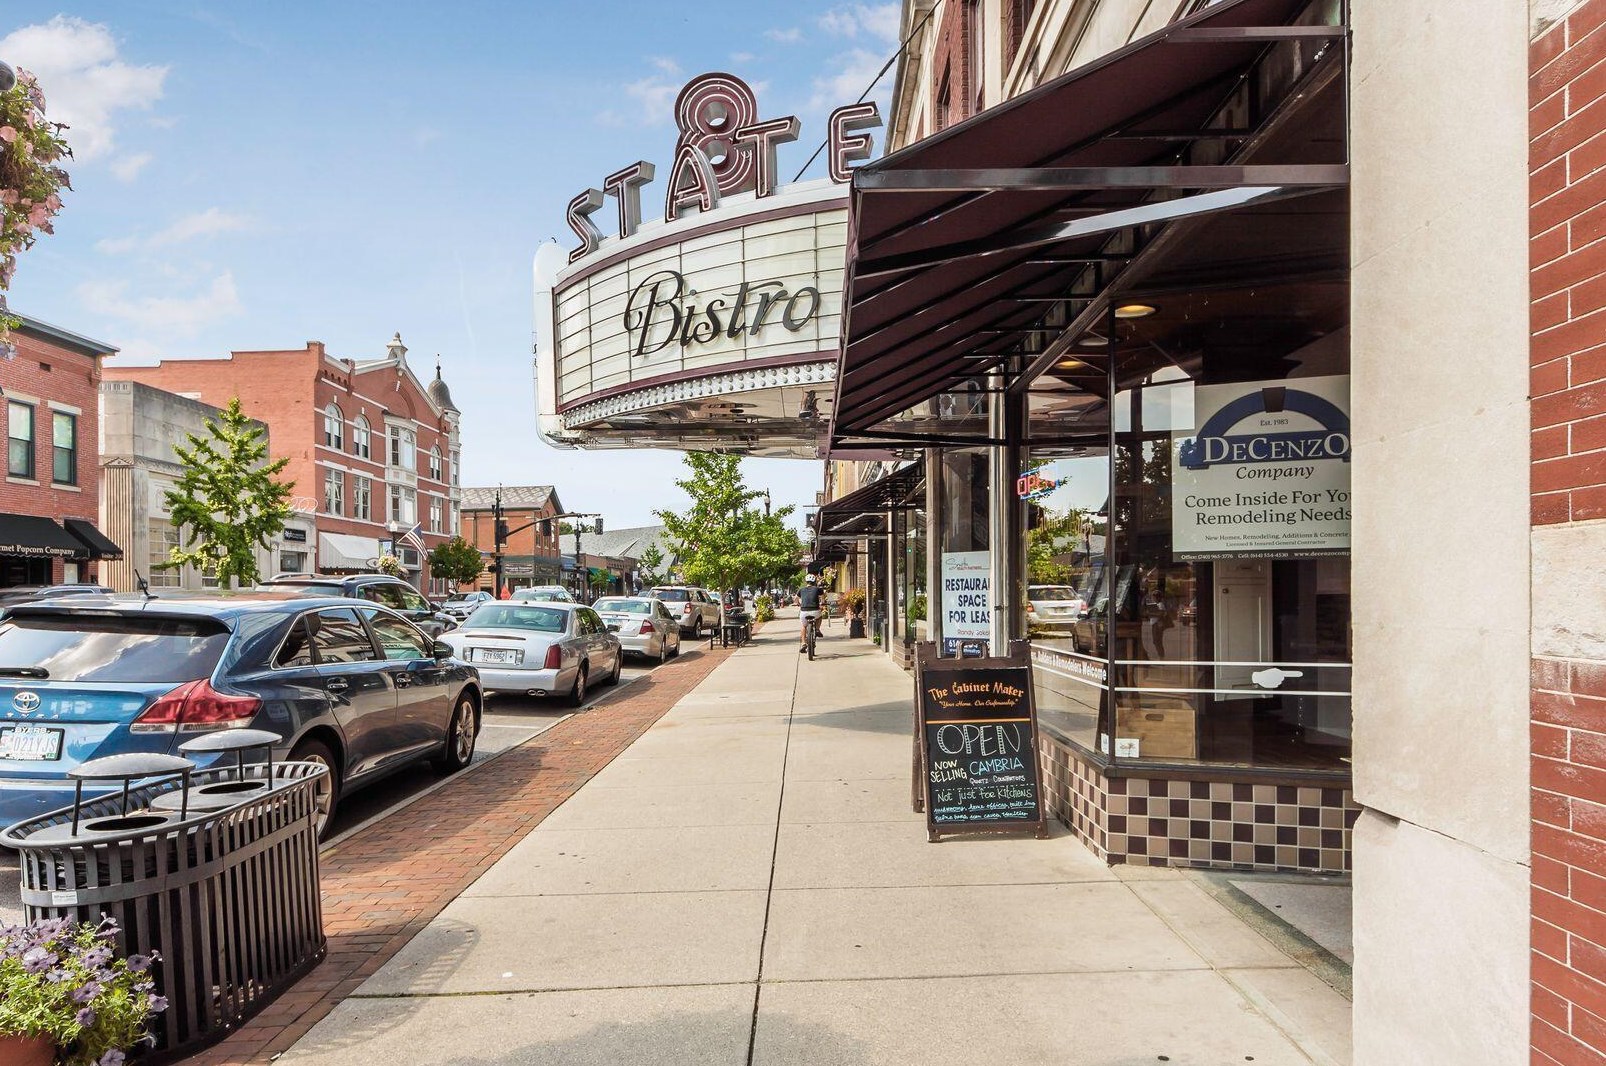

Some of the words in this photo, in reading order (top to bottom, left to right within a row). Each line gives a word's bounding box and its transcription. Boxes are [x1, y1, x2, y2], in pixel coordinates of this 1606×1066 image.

[566, 101, 883, 265] STATE
[623, 270, 821, 358] Bistro
[1260, 419, 1273, 427] Est.
[1273, 418, 1289, 426] 1983
[1236, 465, 1315, 481] Company
[1185, 495, 1232, 508] Come
[1235, 491, 1288, 506] Inside
[1292, 490, 1322, 504] For
[1195, 509, 1297, 526] Remodeling
[1300, 507, 1352, 521] Needs
[16, 544, 44, 555] Popcorn
[45, 546, 75, 557] Company
[945, 577, 990, 592] RESTAURA
[957, 594, 987, 607] SPACE
[948, 611, 967, 624] FOR
[1082, 661, 1107, 681] Welcome
[928, 687, 949, 701] The
[952, 681, 990, 696] Cabinet
[992, 681, 1024, 698] Maker
[936, 723, 1022, 757] OPEN
[934, 759, 958, 772] NOW
[969, 756, 1025, 776] CAMBRIA
[930, 767, 968, 783] SELLING
[937, 791, 953, 804] Not
[957, 788, 977, 805] just
